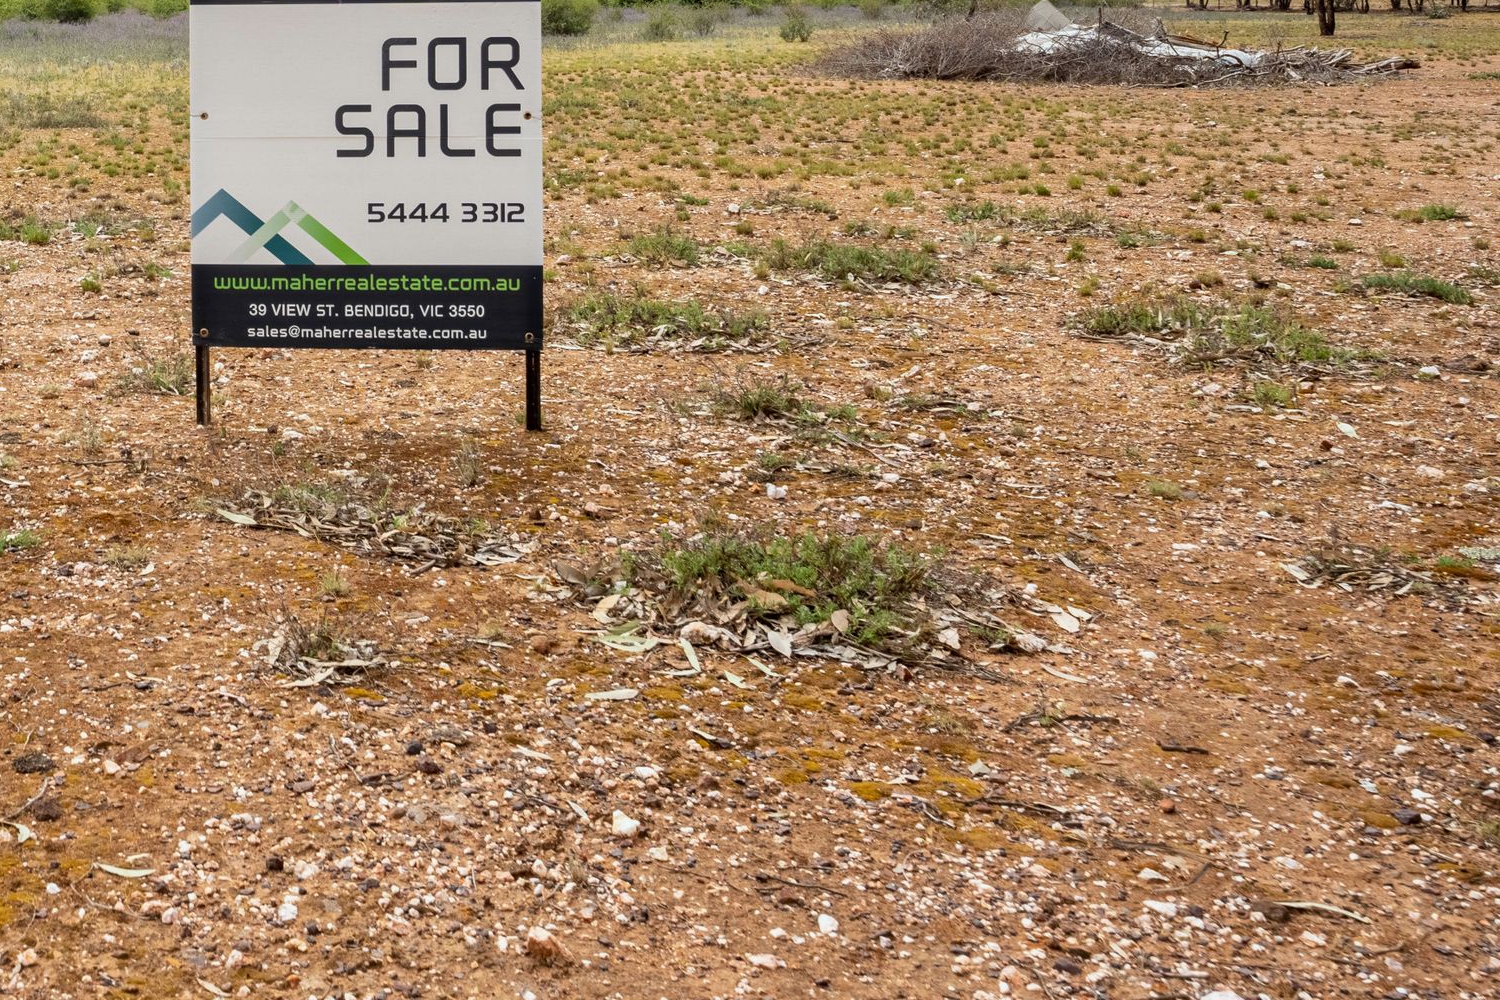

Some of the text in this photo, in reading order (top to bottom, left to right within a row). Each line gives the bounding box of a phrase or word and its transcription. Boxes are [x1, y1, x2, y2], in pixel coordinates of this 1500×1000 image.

[381, 37, 525, 91] FOR
[335, 103, 521, 159] SALE
[367, 202, 525, 223] 5444 3312
[213, 274, 521, 291] www.maherrealestate.com.au
[249, 303, 485, 319] 39 VIEW ST. BENDIGO, VIC 3550
[247, 325, 487, 339] sales@maherrealestate.com.au
